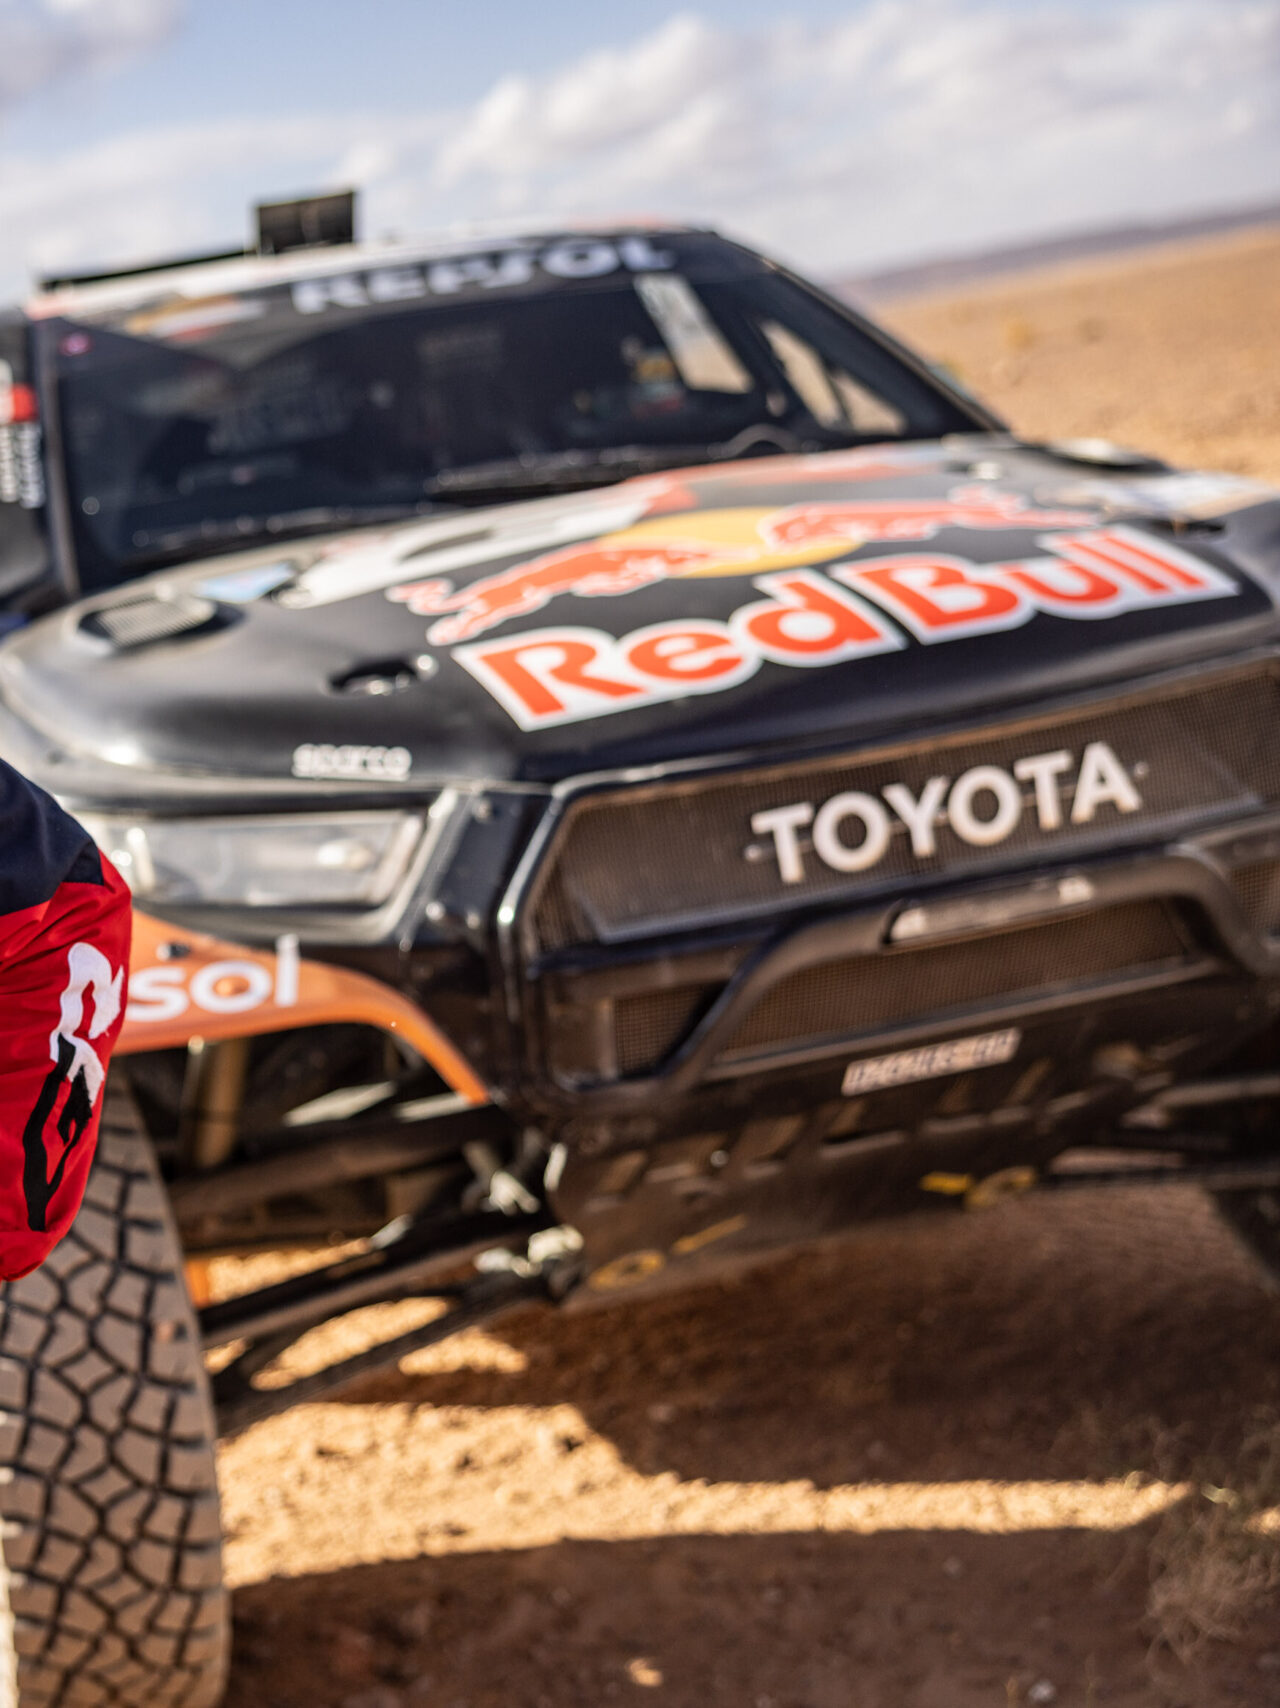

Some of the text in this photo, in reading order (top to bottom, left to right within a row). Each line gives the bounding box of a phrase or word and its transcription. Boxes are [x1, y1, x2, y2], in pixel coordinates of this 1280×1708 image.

[451, 525, 1239, 731] Red Bull
[751, 743, 1141, 884] TOYOTA
